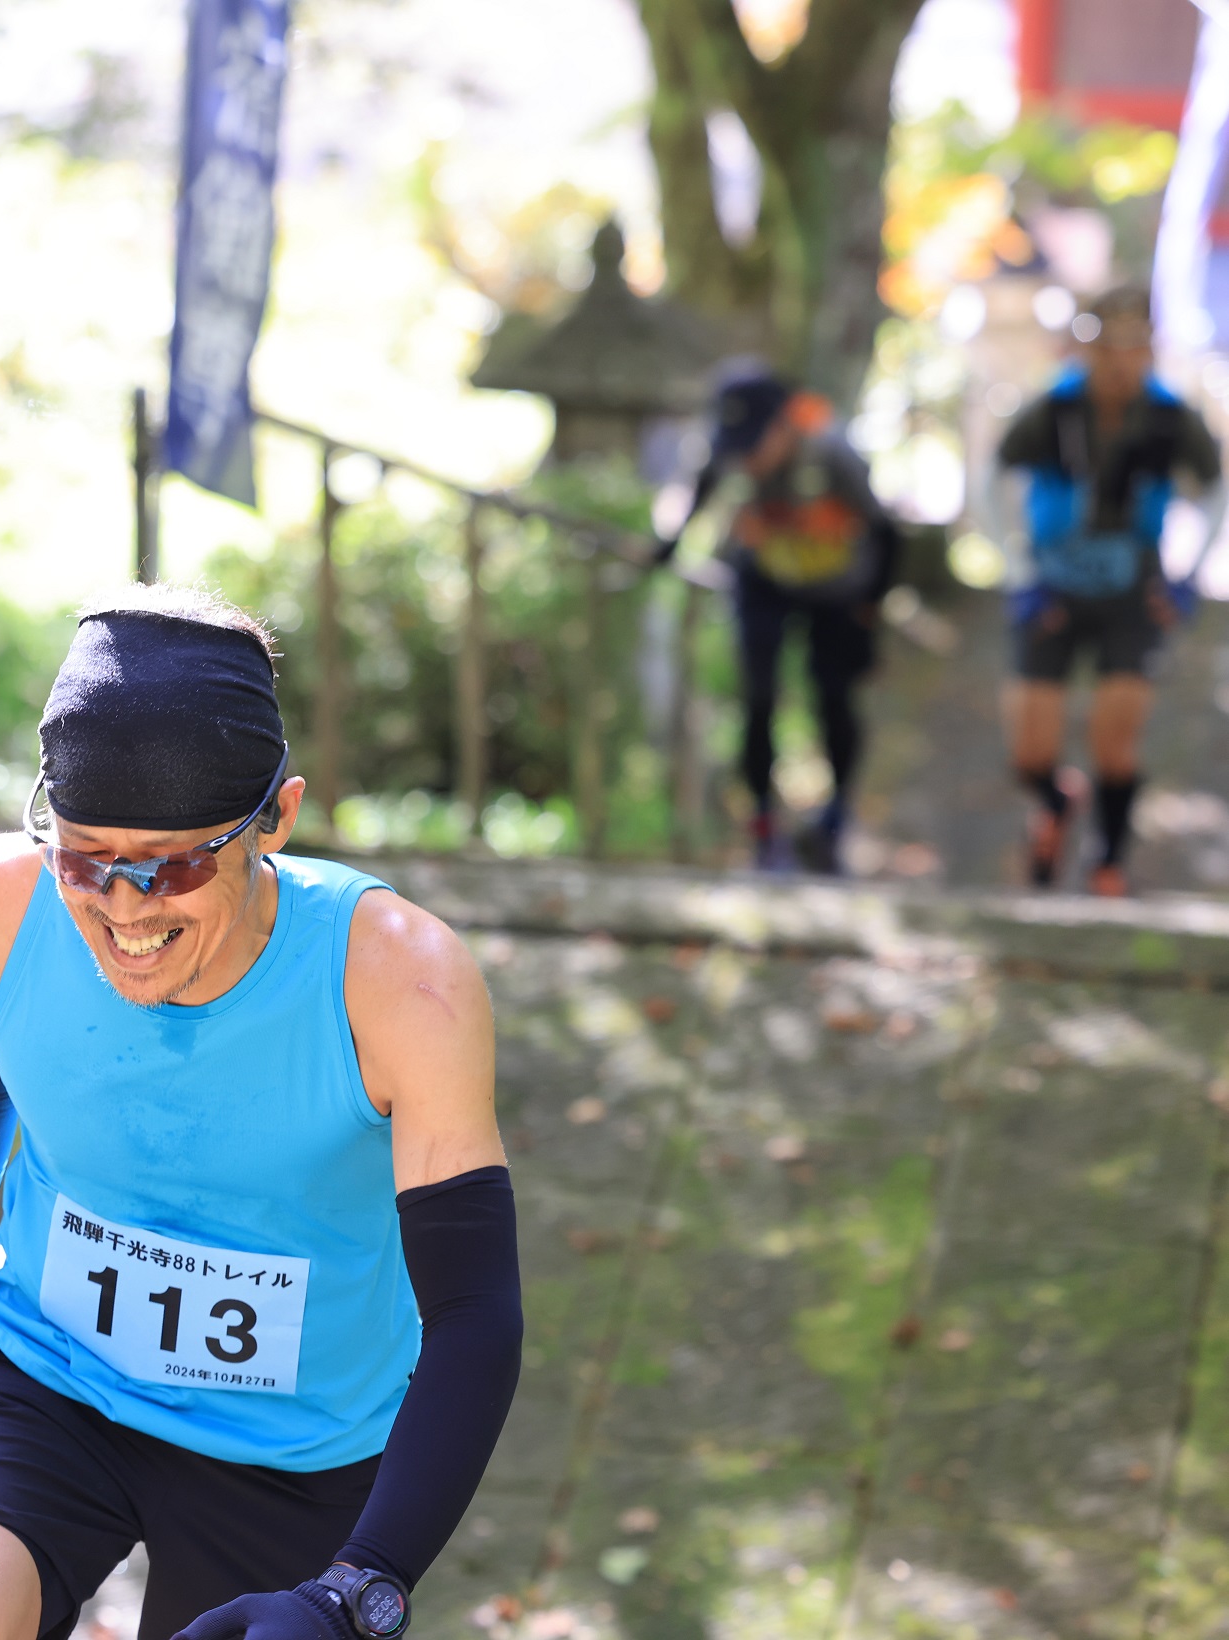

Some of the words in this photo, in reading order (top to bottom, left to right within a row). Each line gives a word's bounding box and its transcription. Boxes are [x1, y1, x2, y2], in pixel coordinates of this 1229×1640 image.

[87, 1266, 258, 1364] 113
[165, 1363, 276, 1387] 2024年10月27日
